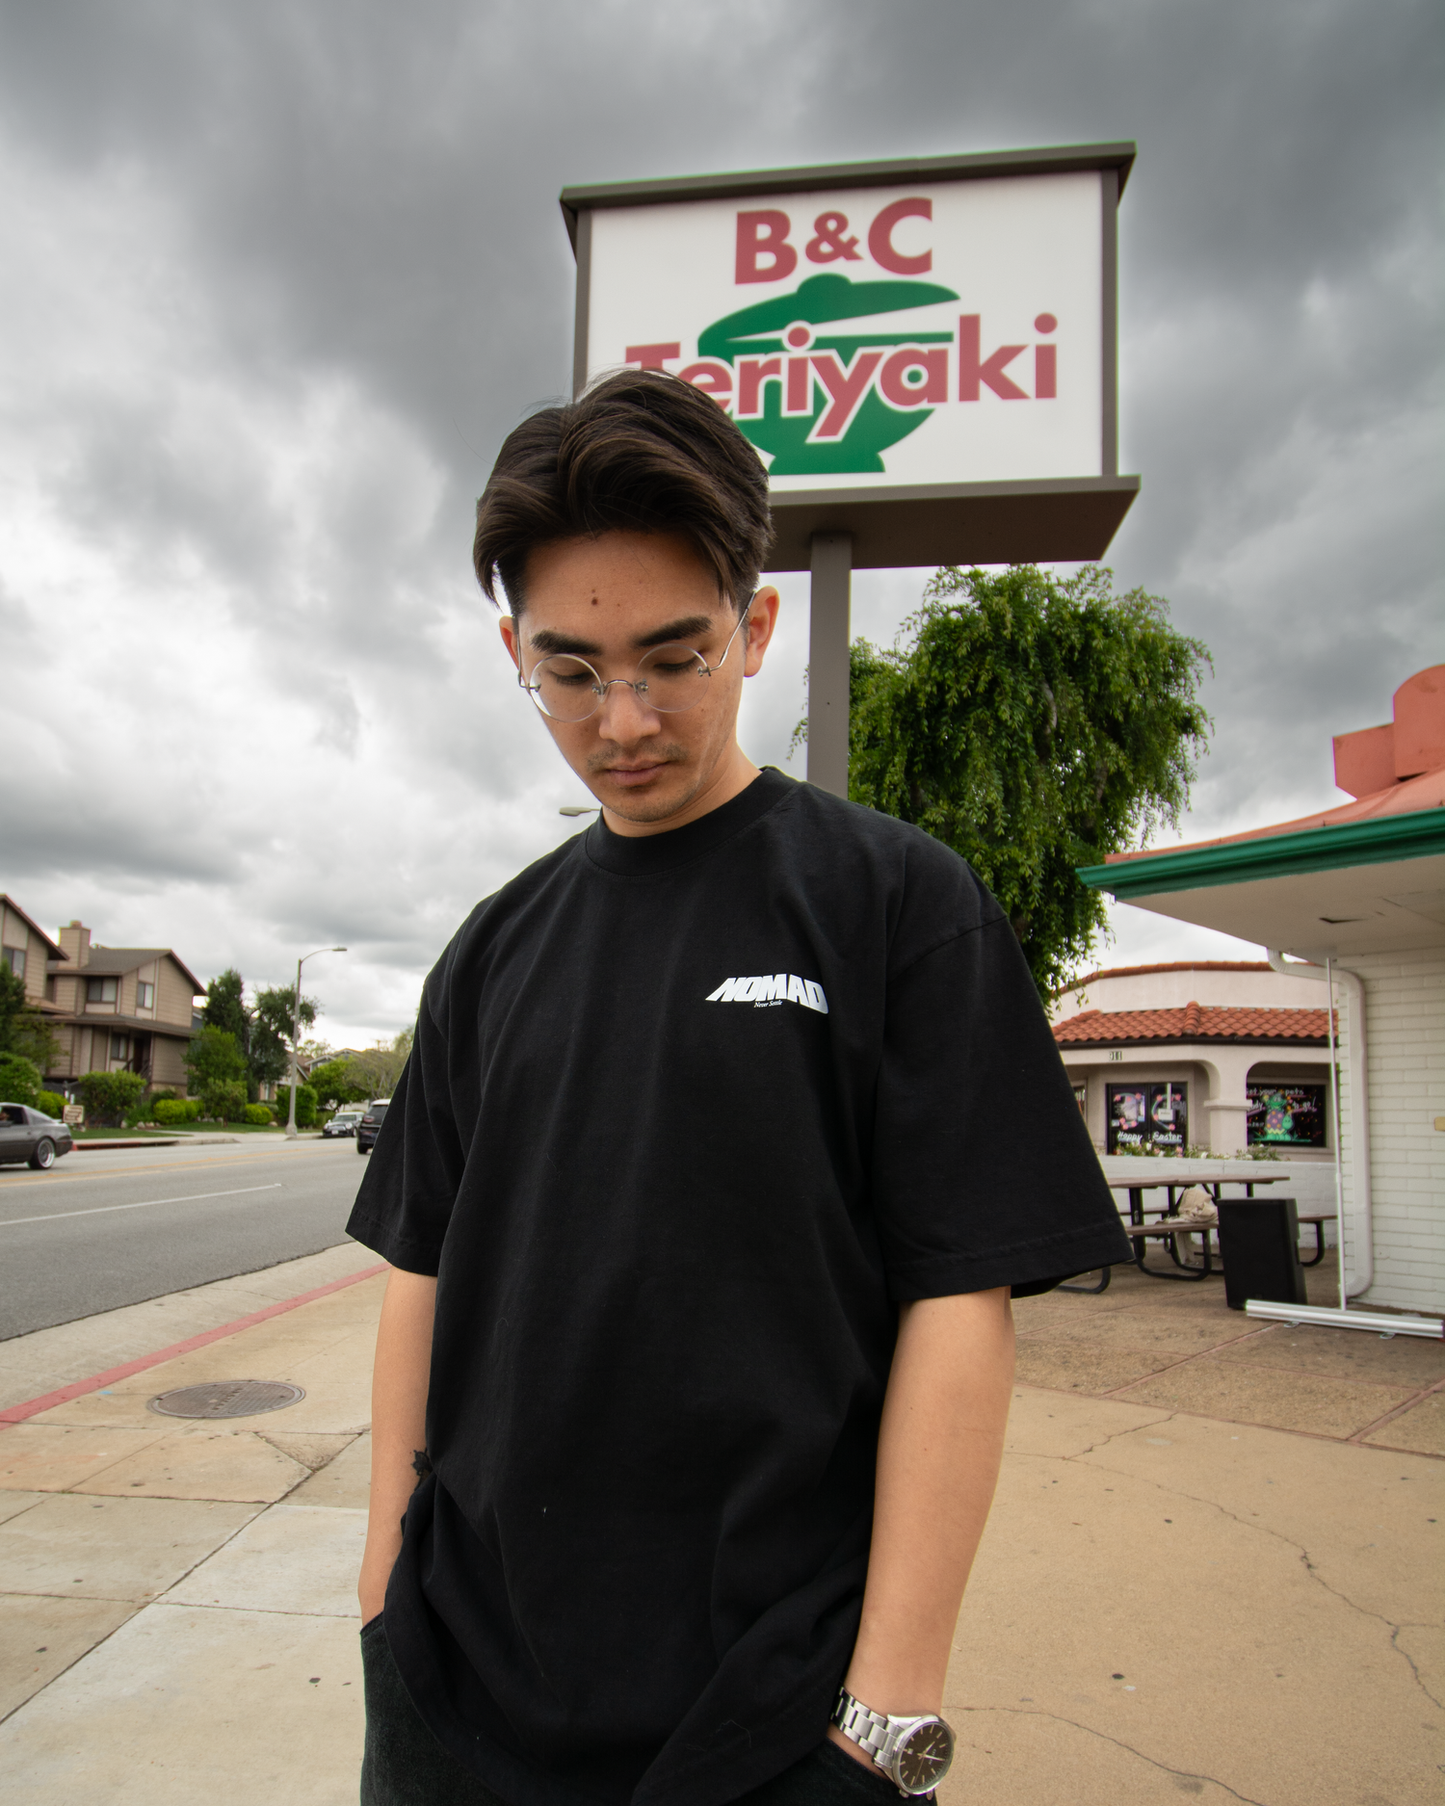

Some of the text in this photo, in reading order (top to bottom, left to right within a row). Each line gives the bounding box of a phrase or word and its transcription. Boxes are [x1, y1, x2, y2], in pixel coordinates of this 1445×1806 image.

[735, 197, 932, 285] B&C
[705, 973, 829, 1014] NOMAD
[1117, 1131, 1183, 1144] Happy Easter
